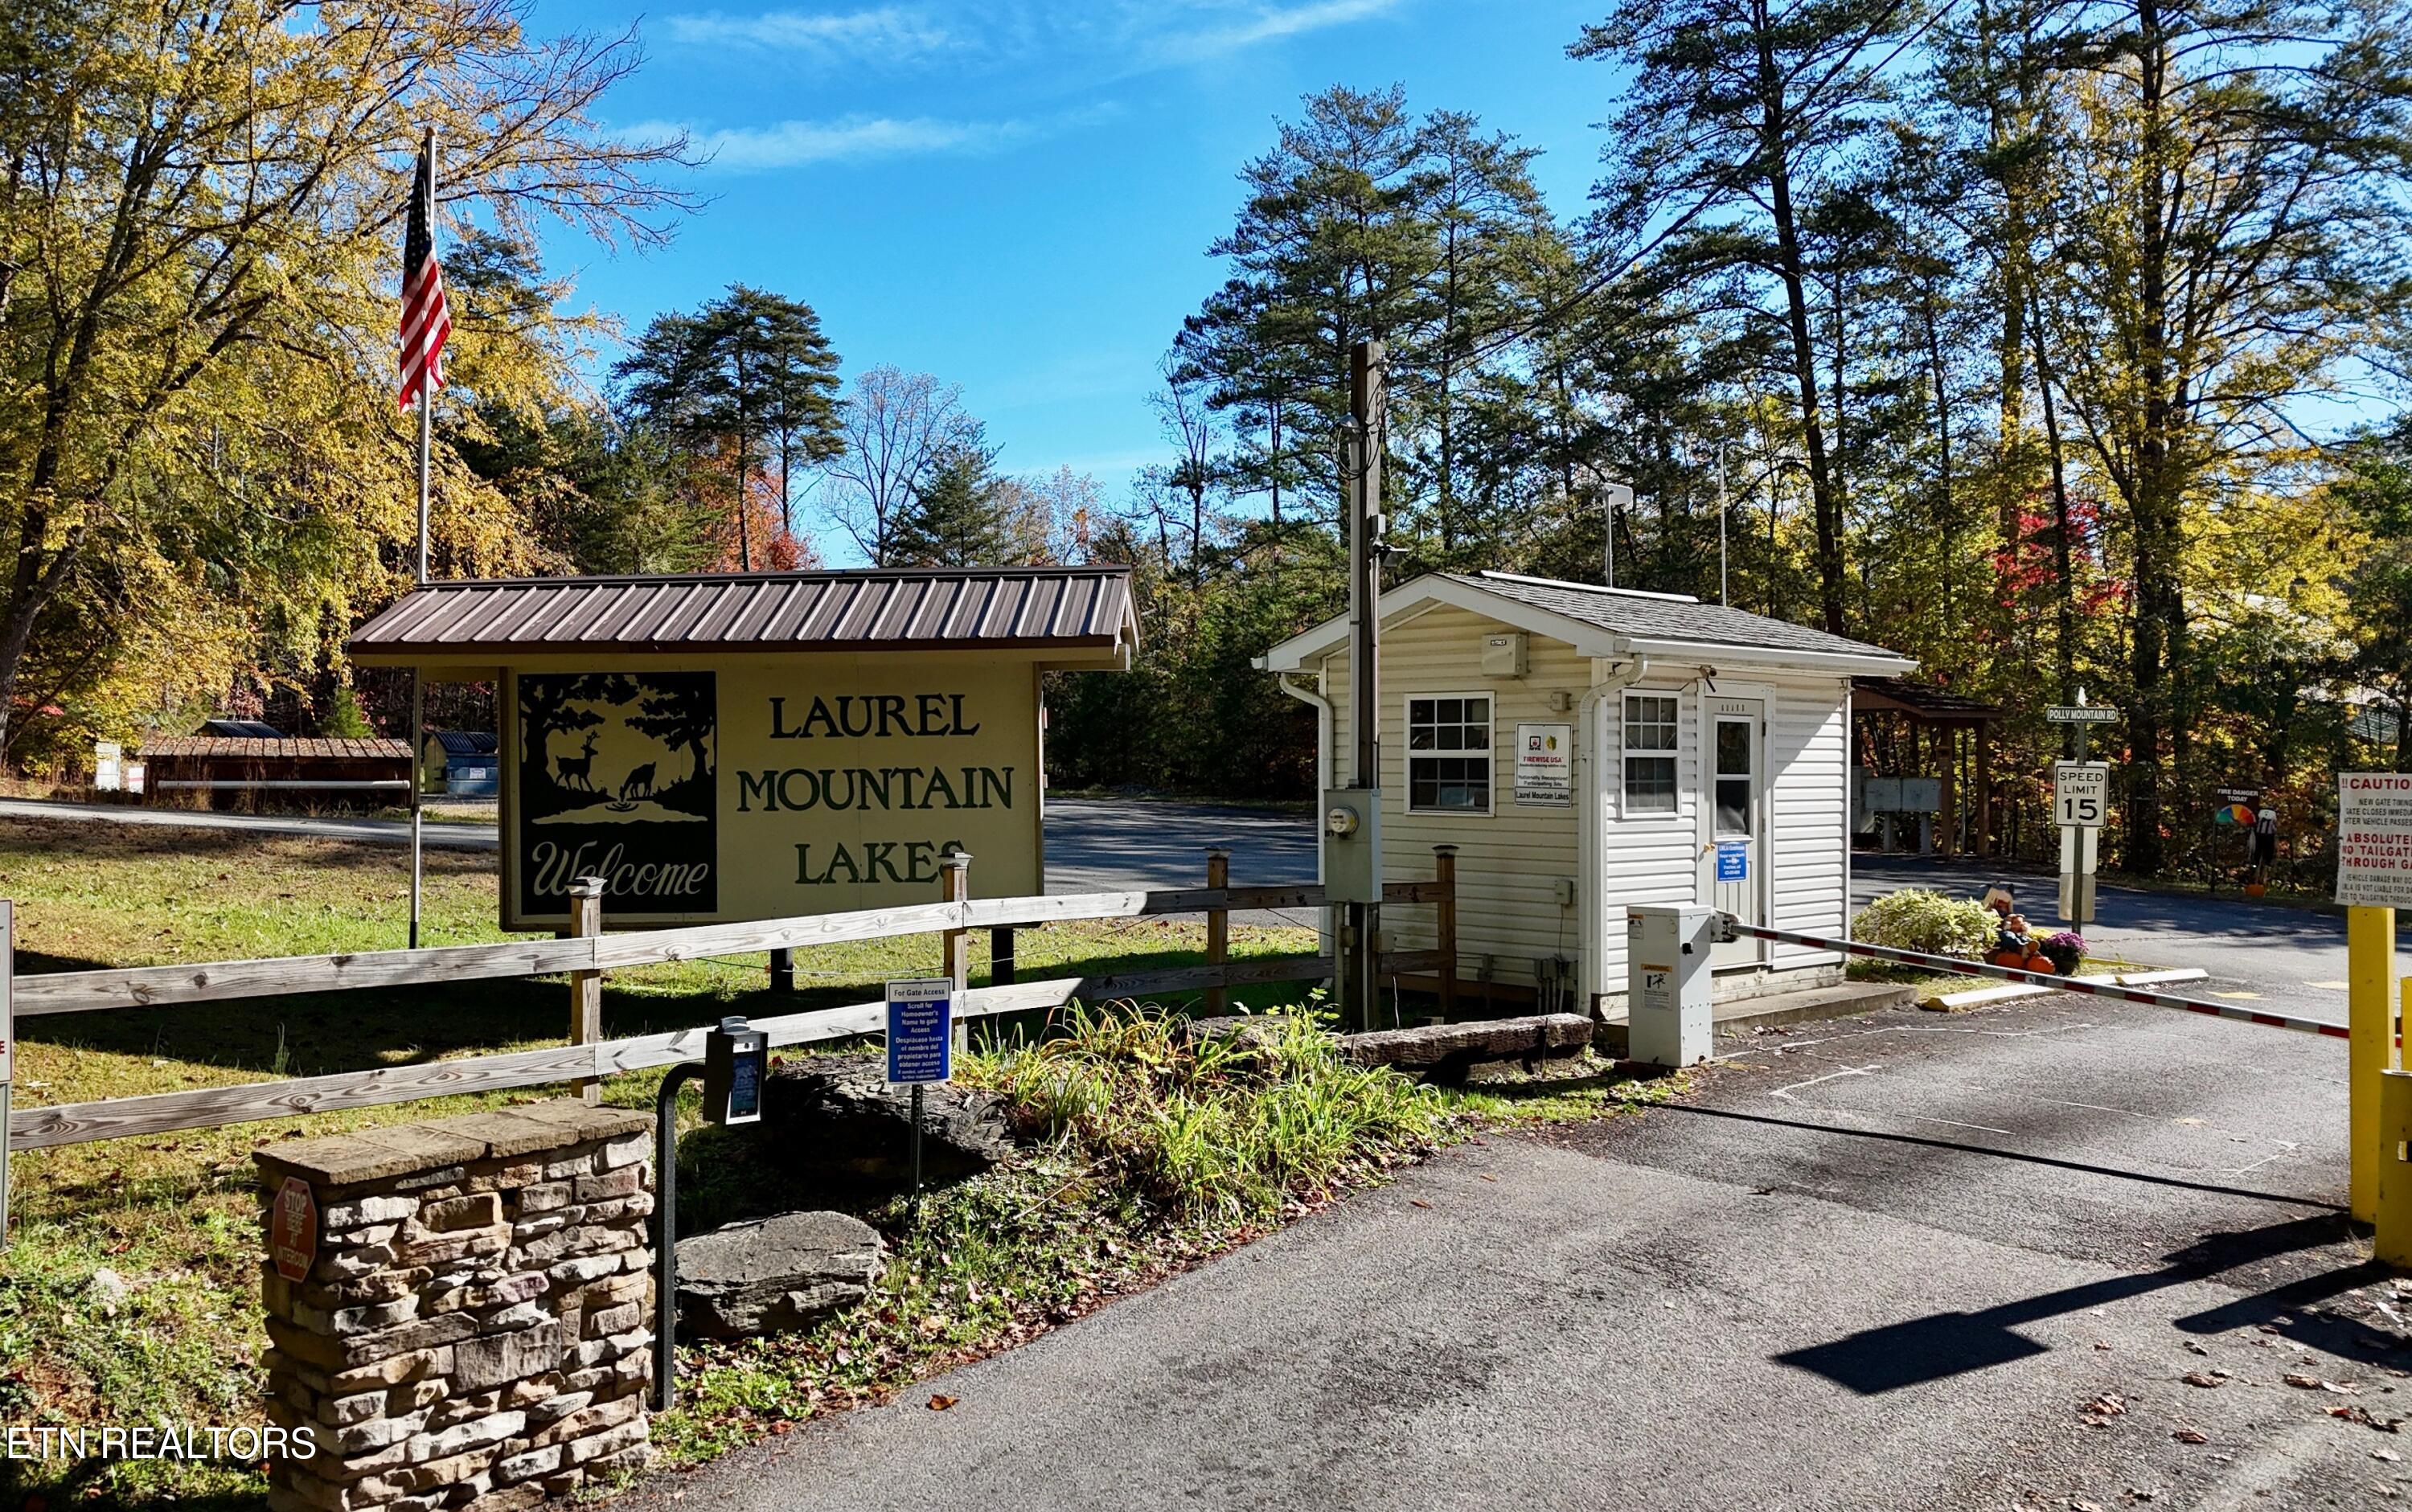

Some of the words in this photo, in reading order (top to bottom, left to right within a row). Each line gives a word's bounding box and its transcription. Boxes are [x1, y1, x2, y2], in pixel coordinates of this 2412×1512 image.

[769, 693, 980, 739] LAUREL
[2049, 710, 2070, 719] POLLY
[2070, 710, 2106, 719] MOUNTAIN
[2106, 711, 2116, 719] RD
[2059, 772, 2103, 781] SPEED
[736, 766, 1015, 812] MOUNTAIN
[2064, 785, 2097, 794] LIMIT
[1516, 790, 1531, 798] Laurel
[1532, 791, 1553, 799] Mountain
[2375, 798, 2391, 806] GATE
[2065, 798, 2098, 820] 15
[2362, 808, 2387, 816] CLOSES
[2363, 817, 2388, 826] VEHICLE
[2347, 834, 2412, 845] ABSOLUTE
[2342, 846, 2354, 854] NO
[2342, 856, 2395, 868] THROUGH
[906, 989, 922, 997] Gate
[285, 1190, 306, 1214] STOP
[277, 1245, 309, 1268] INTERCOM
